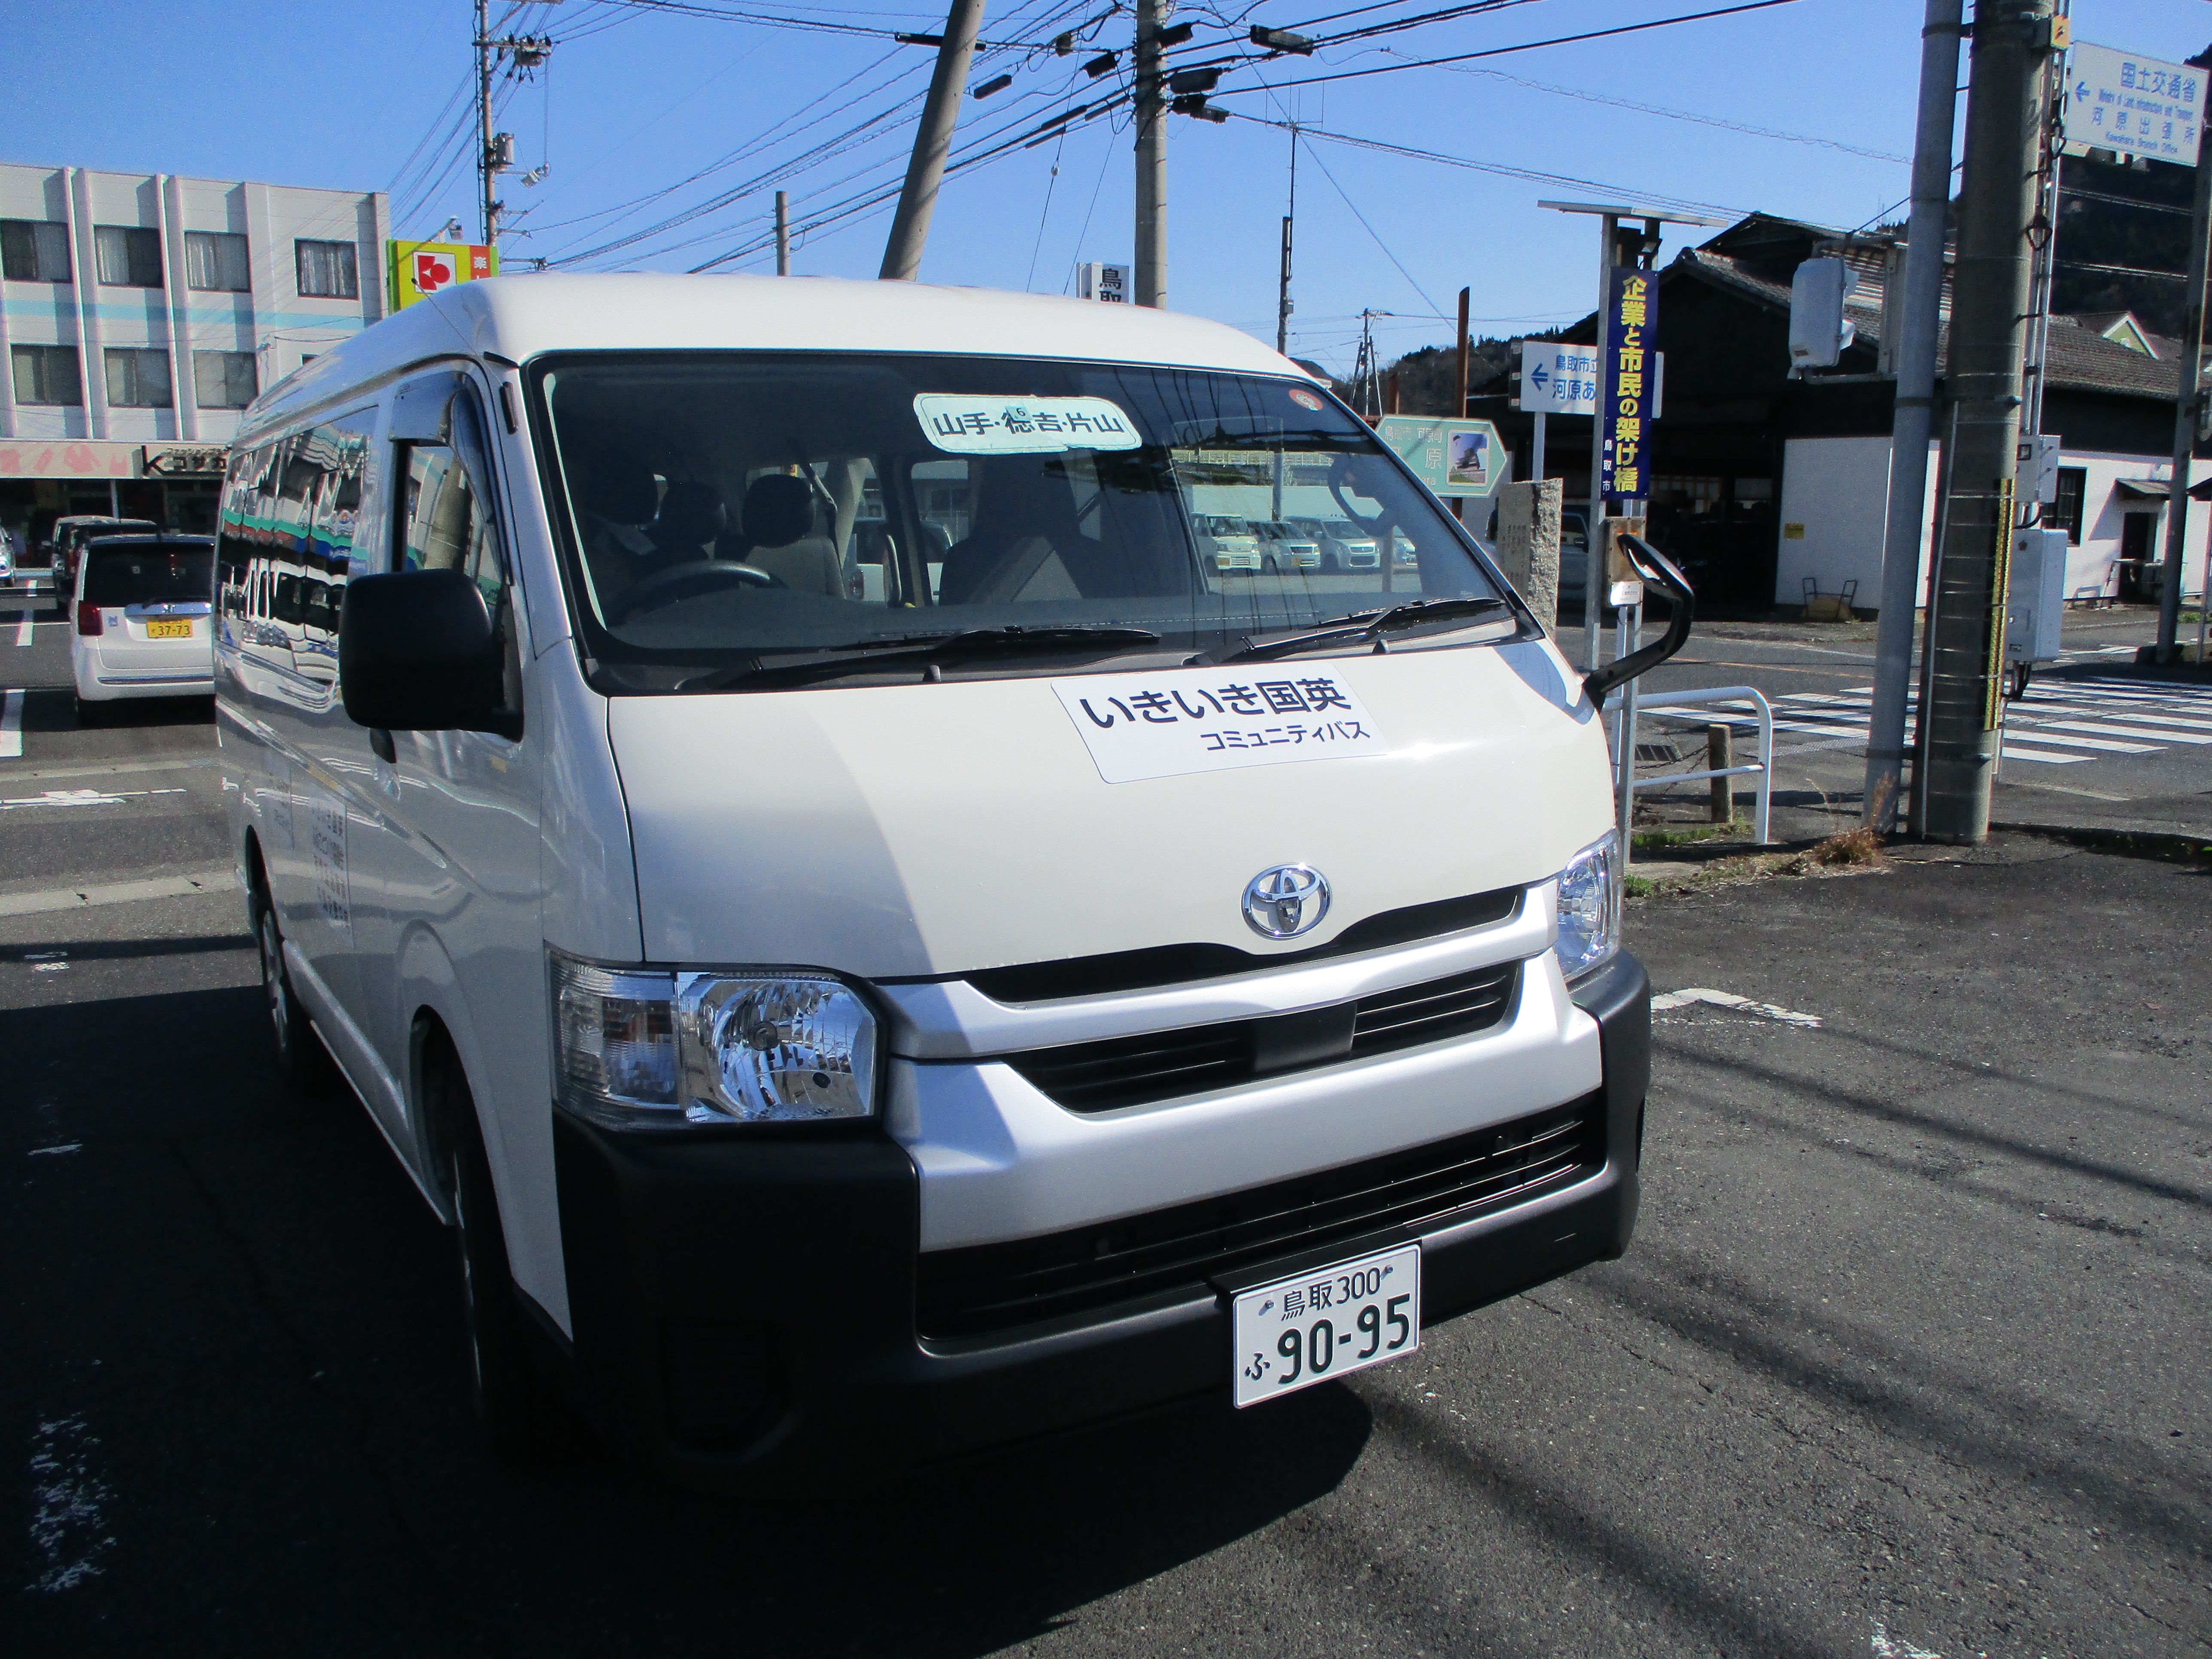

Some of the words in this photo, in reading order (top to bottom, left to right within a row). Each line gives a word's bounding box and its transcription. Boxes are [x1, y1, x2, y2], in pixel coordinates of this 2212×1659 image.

[2121, 62, 2197, 103] 国土交通省
[1613, 275, 1647, 492] 企業と市民の架け橋
[1016, 407, 1026, 416] 6
[1602, 439, 1613, 491] 鳥取市
[158, 625, 191, 635] 37-73
[1079, 677, 1352, 729] いきいき国英
[1200, 721, 1371, 750] コミュニティバス
[1245, 1352, 1270, 1381] ふ
[1278, 1293, 1410, 1385] 90-95
